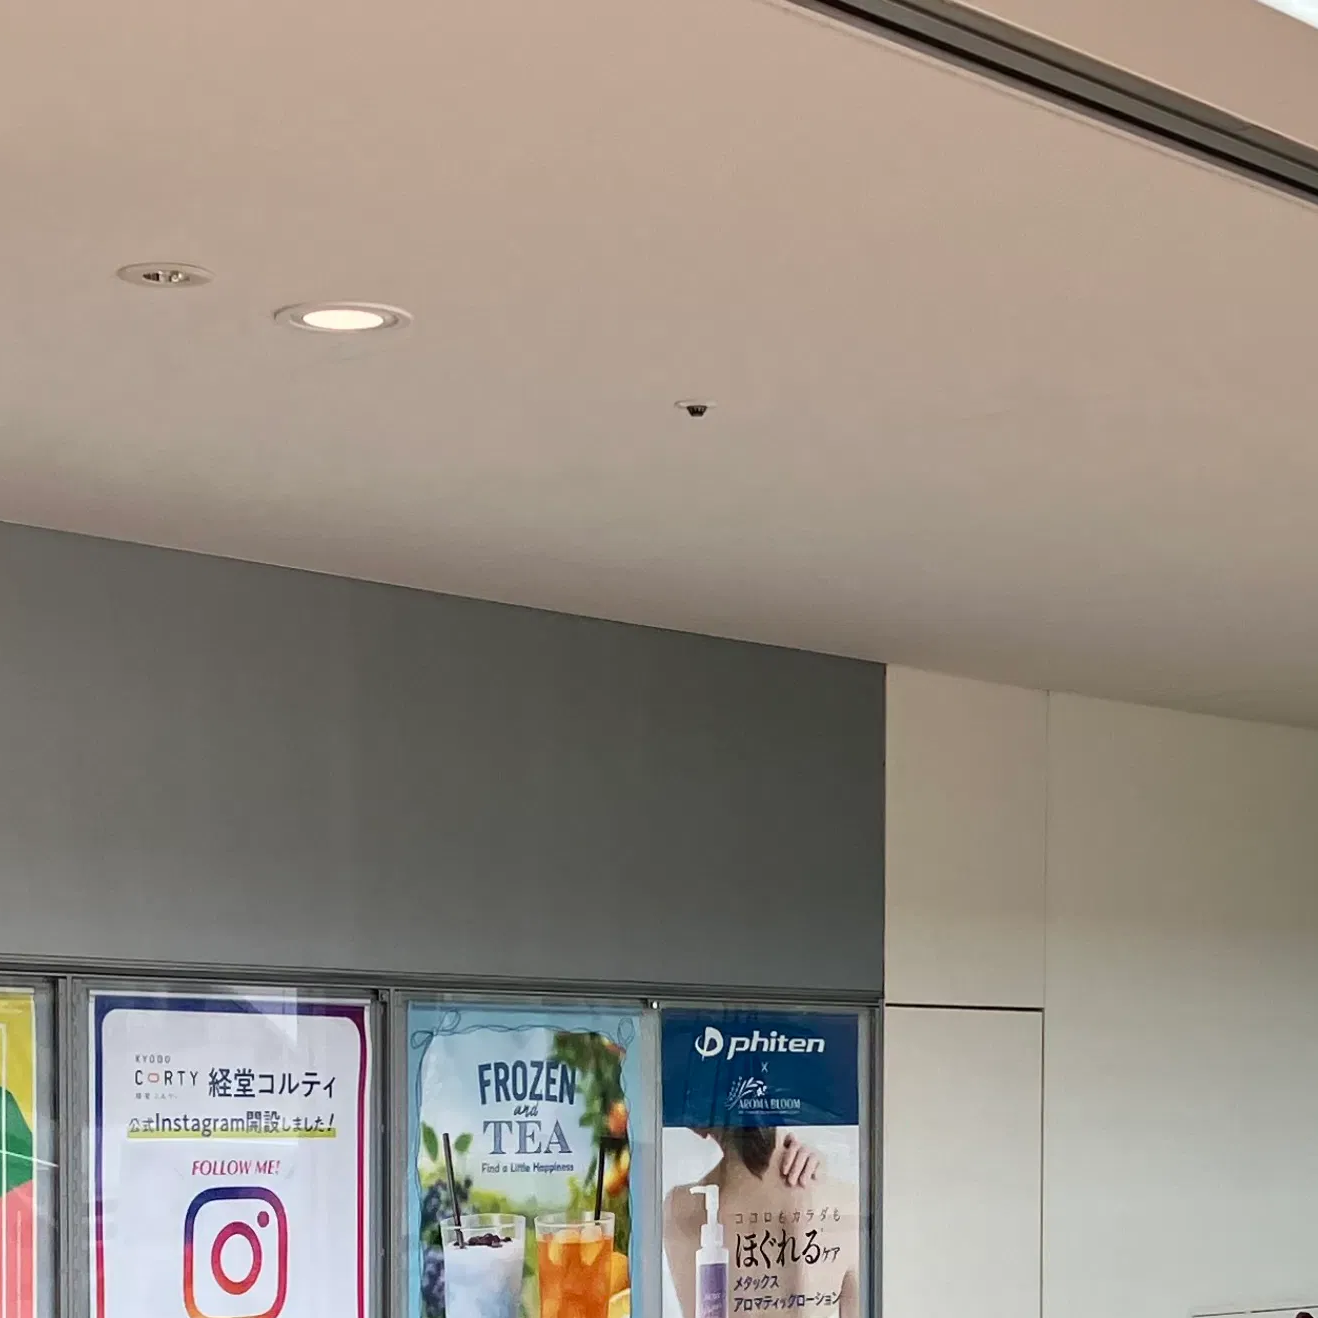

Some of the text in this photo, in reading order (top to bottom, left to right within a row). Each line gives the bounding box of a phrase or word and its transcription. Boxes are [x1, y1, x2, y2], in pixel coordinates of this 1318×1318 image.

[727, 1030, 825, 1060] phiten
[208, 1067, 337, 1099] 経堂コルティ
[478, 1060, 576, 1106] FROZEN
[483, 1119, 573, 1155] TEA
[191, 1159, 281, 1176] FOLLOW ME!
[481, 1162, 500, 1173] Find
[533, 1161, 575, 1174] Happiness
